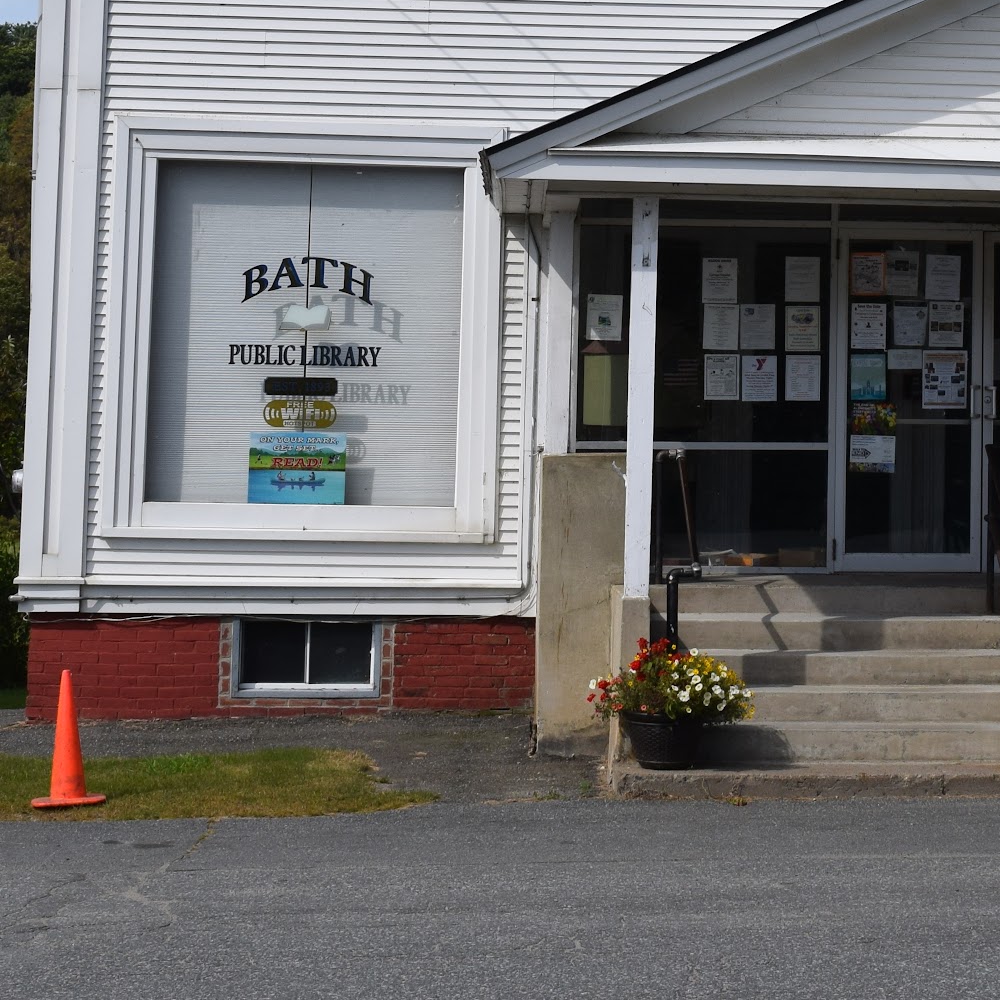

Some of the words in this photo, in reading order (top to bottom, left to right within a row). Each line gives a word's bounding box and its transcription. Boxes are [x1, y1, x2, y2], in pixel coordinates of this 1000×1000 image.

[241, 256, 374, 305] BATH
[228, 344, 296, 366] PUBLIC
[300, 345, 382, 367] LIBRARY
[286, 401, 314, 409] FREE
[277, 436, 304, 444] YOUR
[273, 444, 293, 452] GET
[272, 457, 323, 468] READ!
